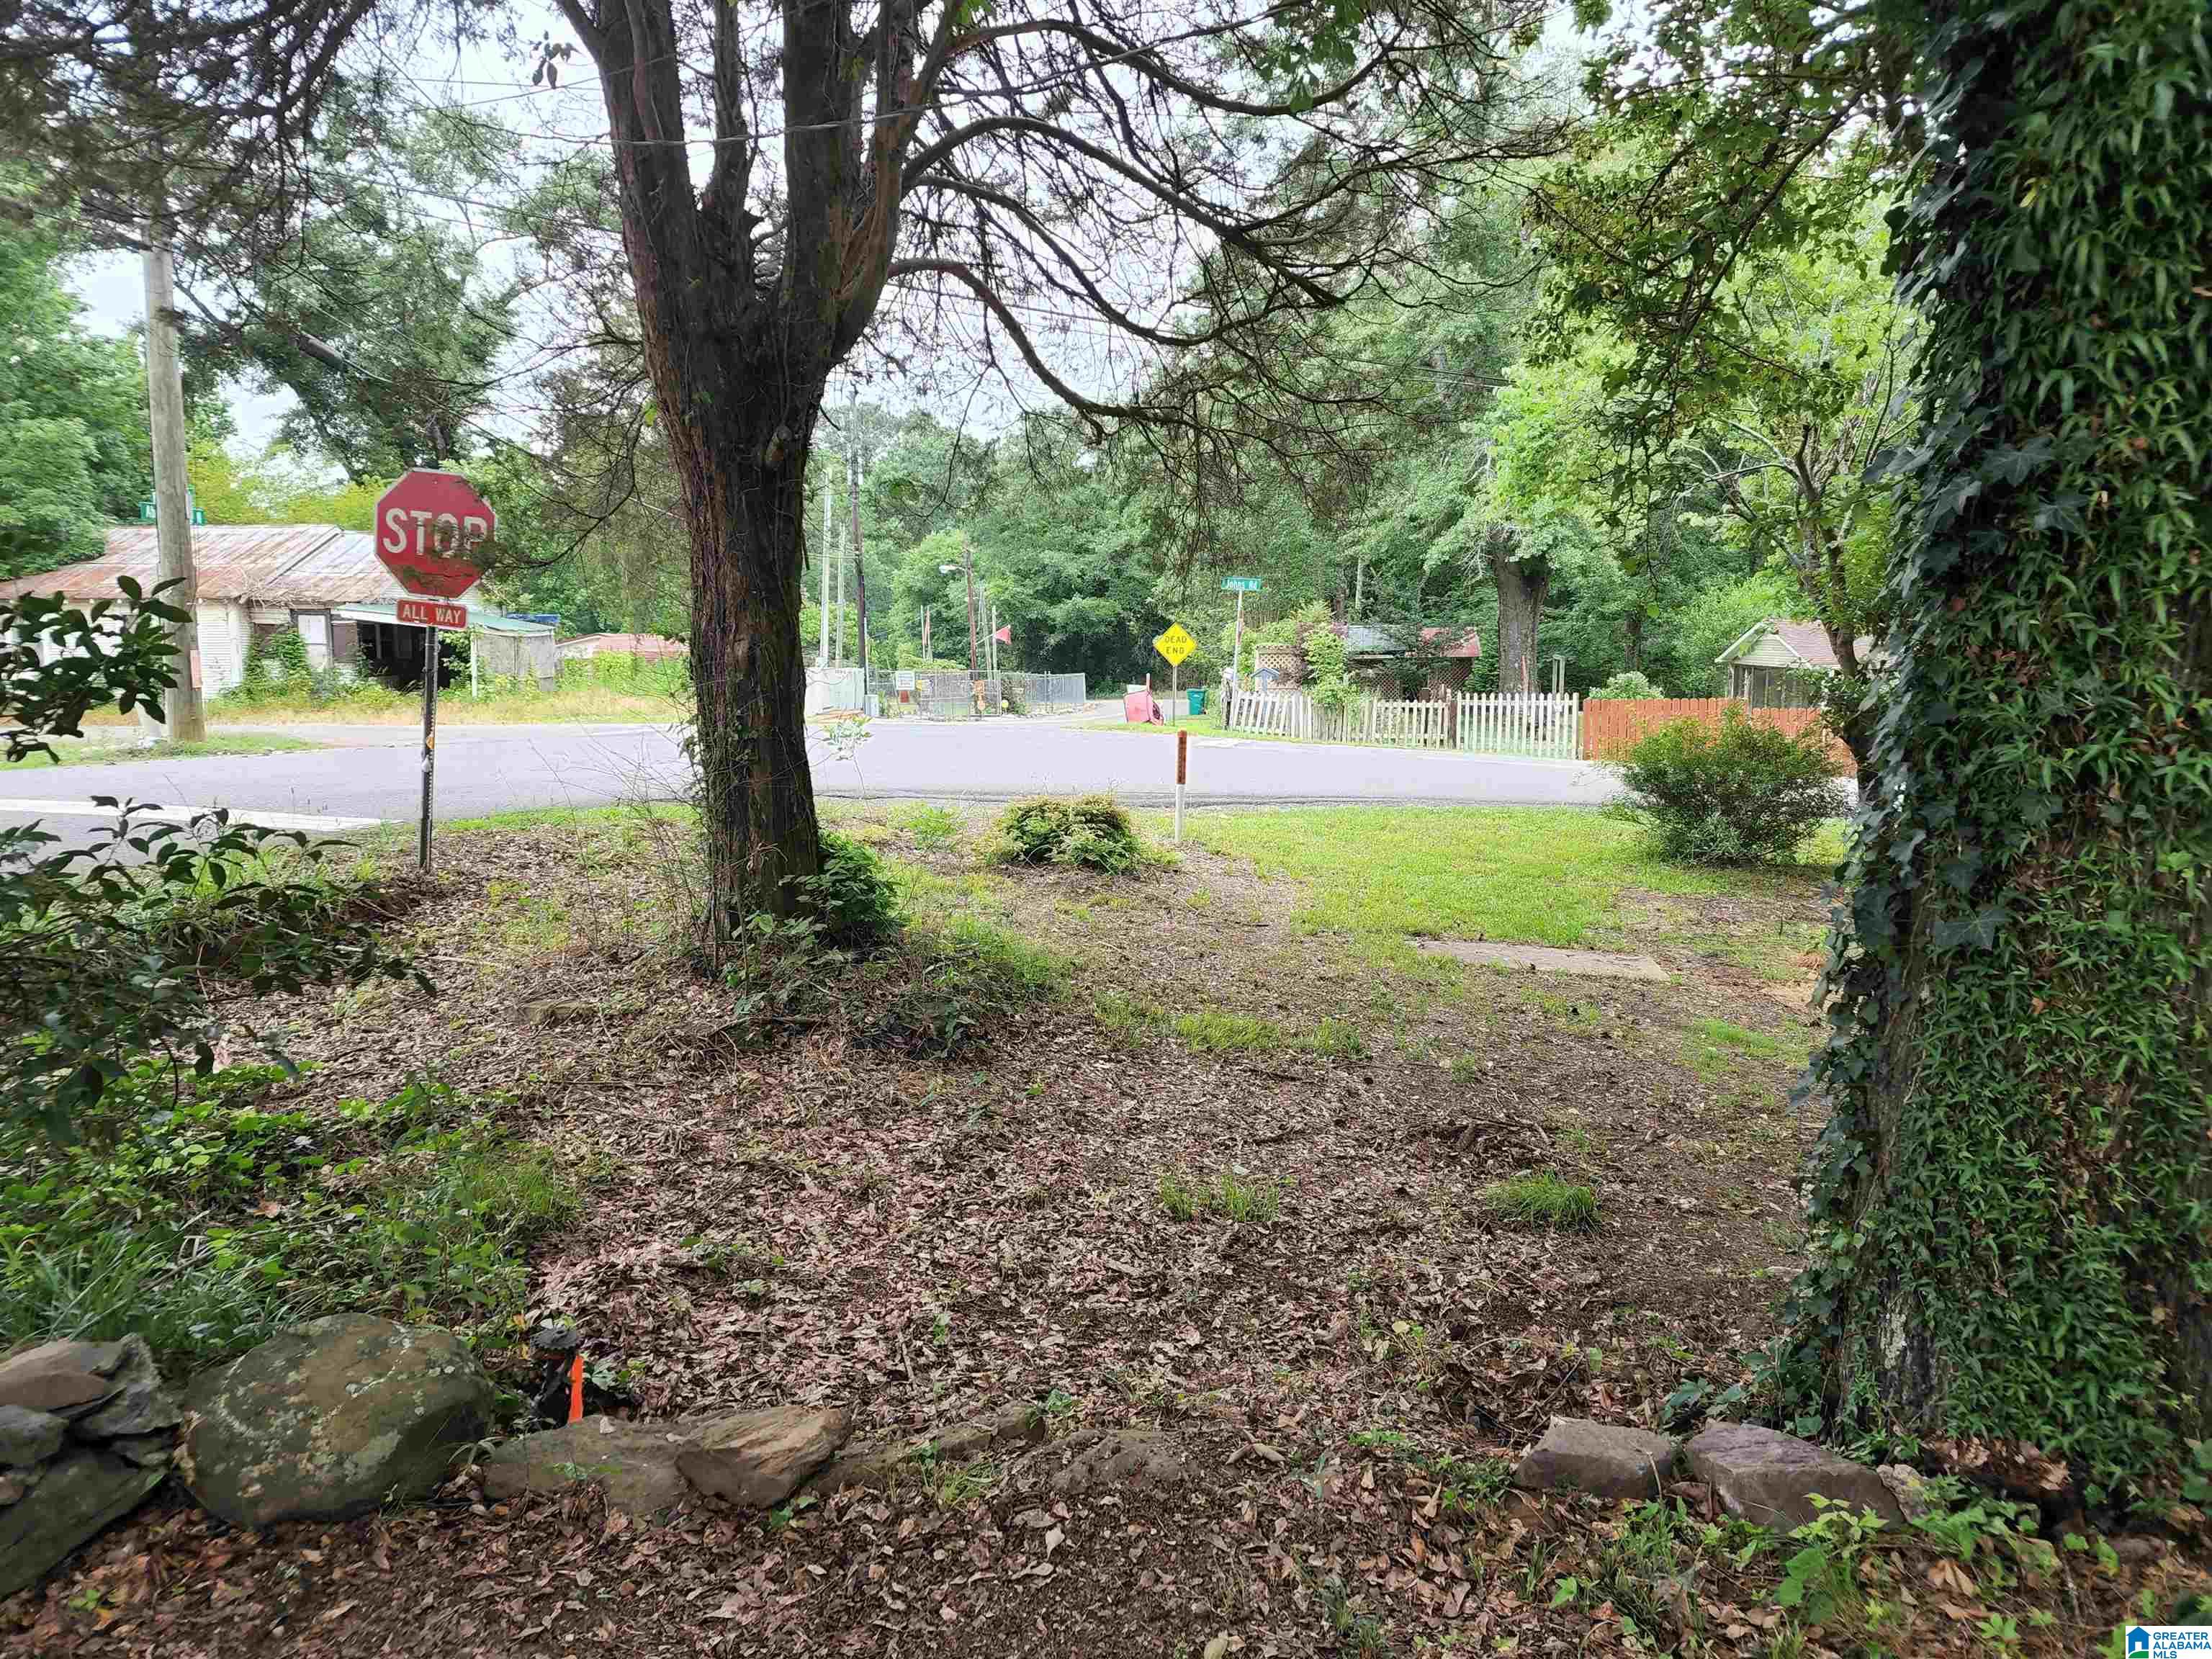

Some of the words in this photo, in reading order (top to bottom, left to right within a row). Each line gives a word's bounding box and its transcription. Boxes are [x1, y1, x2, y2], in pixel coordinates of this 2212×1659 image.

[382, 507, 487, 559] STOP
[403, 604, 428, 620] ALL
[435, 608, 462, 624] WAY
